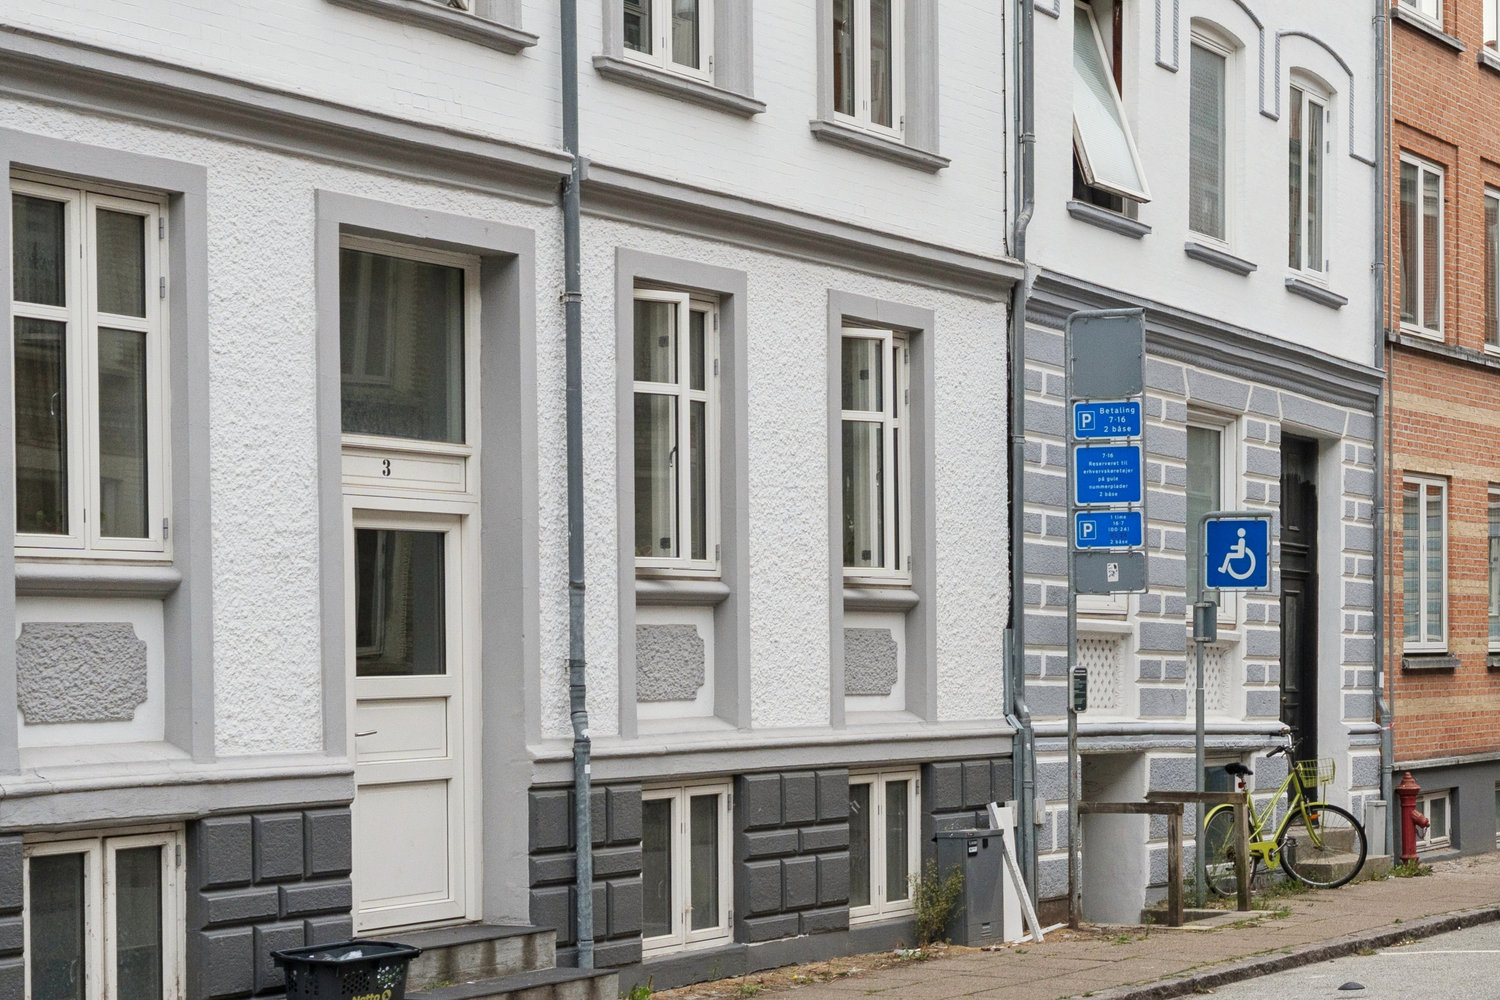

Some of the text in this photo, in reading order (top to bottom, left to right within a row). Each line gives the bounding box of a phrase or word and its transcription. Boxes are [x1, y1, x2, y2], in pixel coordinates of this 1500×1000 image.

[1082, 414, 1092, 428] P
[382, 459, 391, 477] 3
[1083, 523, 1093, 537] P
